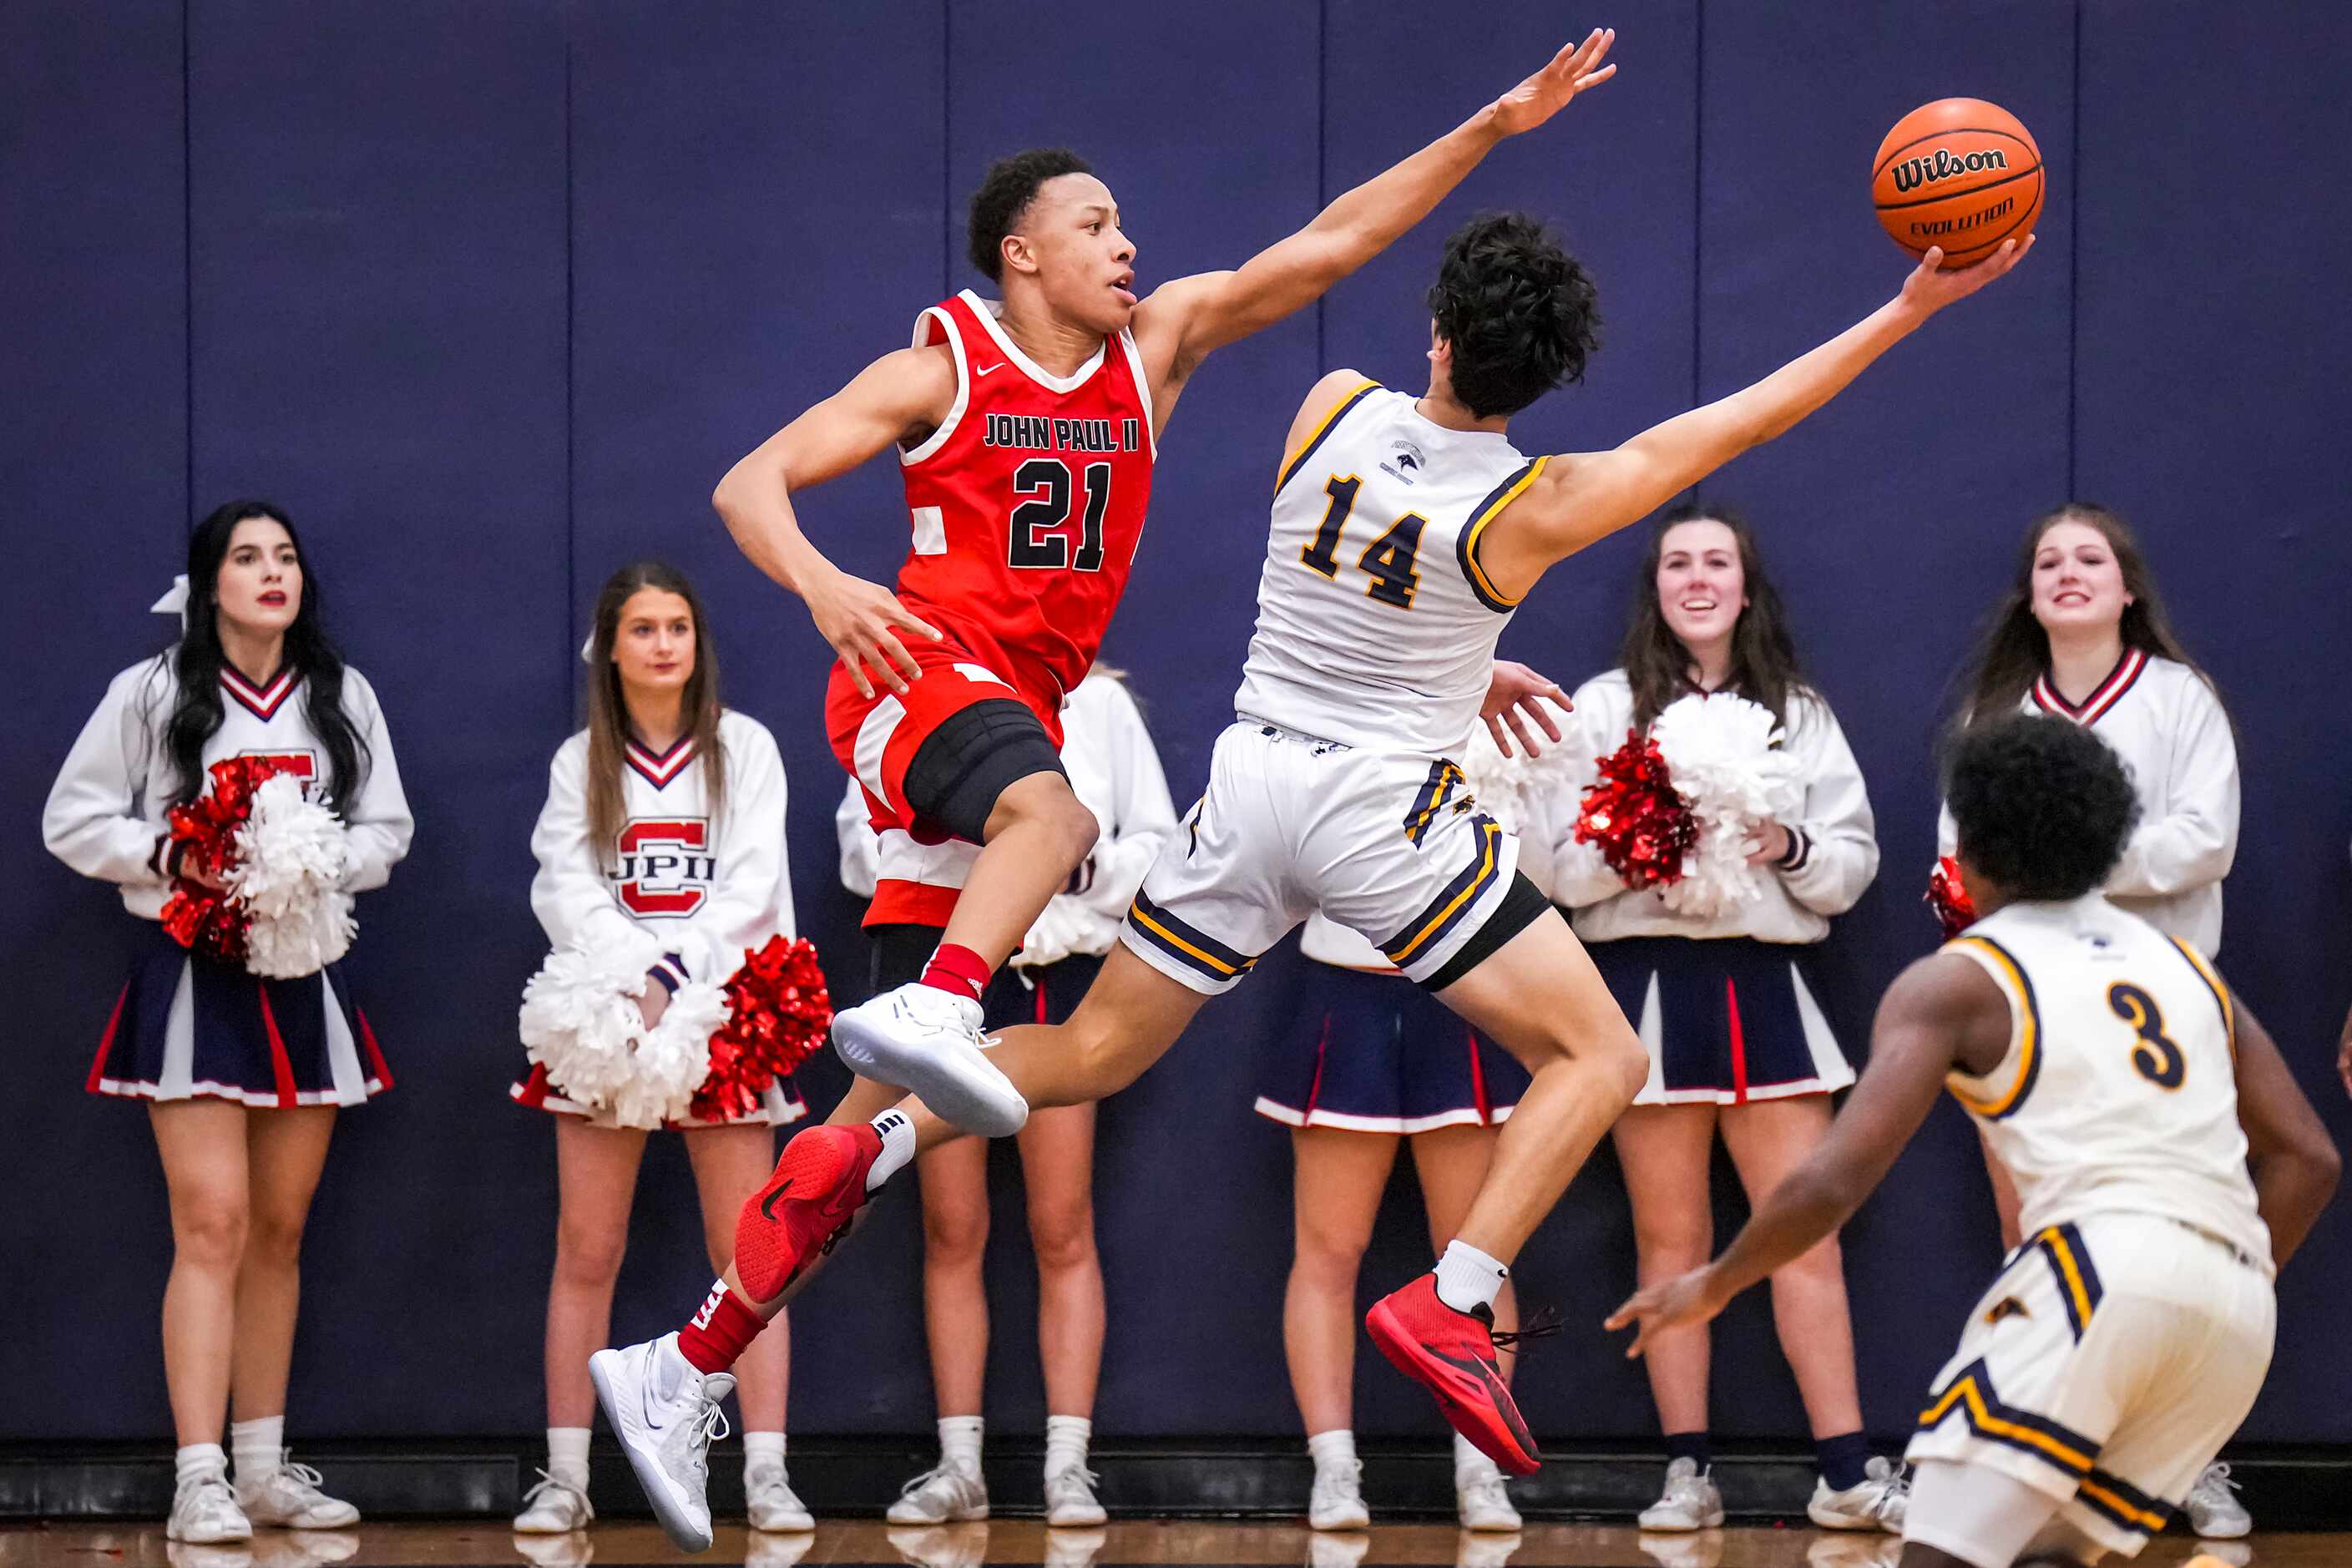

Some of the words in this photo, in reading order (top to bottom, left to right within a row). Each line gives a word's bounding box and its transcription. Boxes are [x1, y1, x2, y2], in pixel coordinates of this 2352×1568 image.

[1891, 148, 2008, 192] Wilson
[1910, 197, 2013, 235] EVOLUTION
[983, 413, 1050, 449] JOHN
[1053, 418, 1119, 453] PAUL
[1122, 418, 1139, 452] II
[1008, 458, 1111, 572] 21
[1299, 473, 1430, 611] 14
[608, 856, 716, 881] JPII
[2107, 980, 2187, 1093] 3
